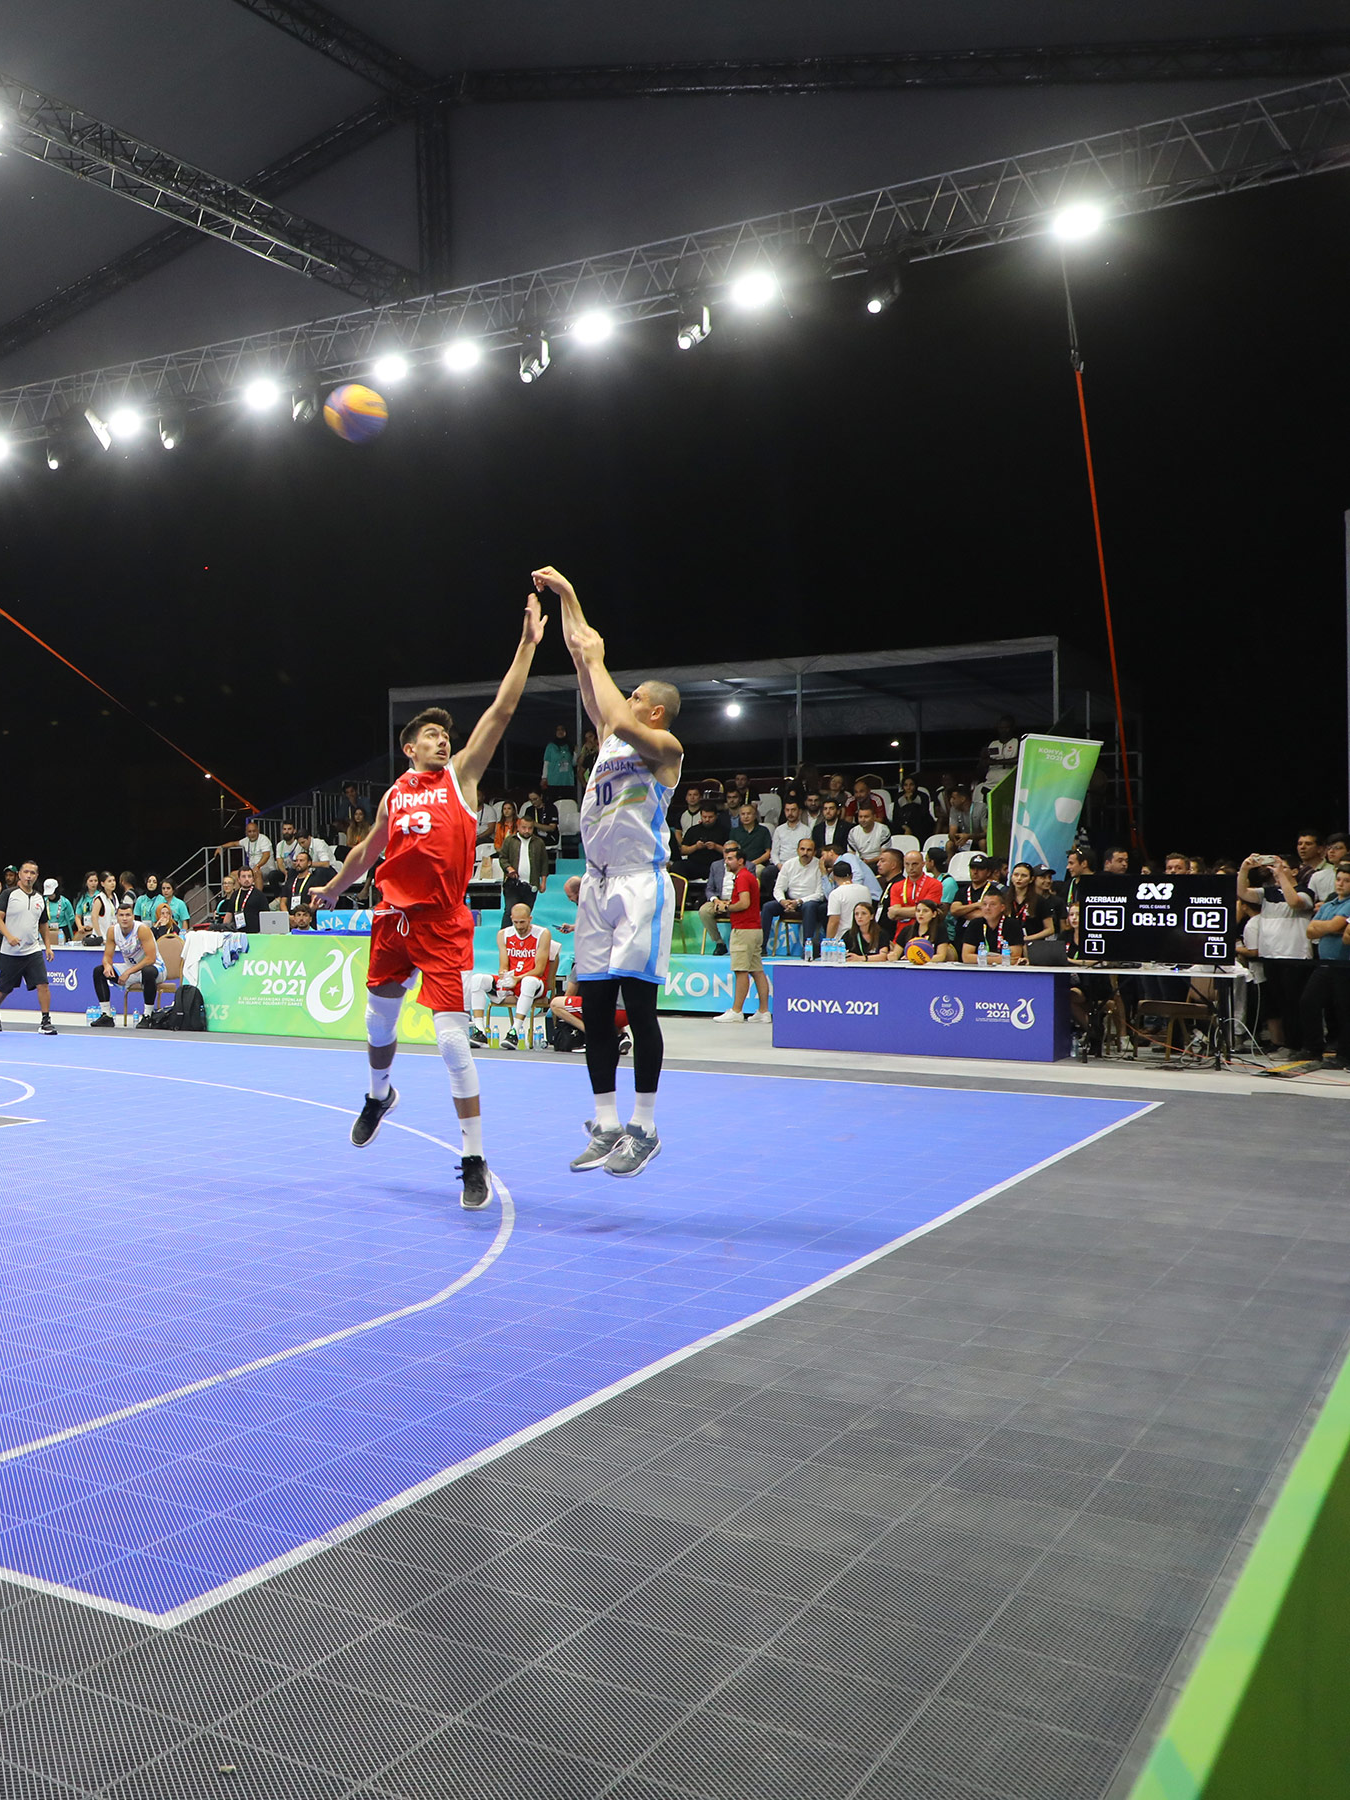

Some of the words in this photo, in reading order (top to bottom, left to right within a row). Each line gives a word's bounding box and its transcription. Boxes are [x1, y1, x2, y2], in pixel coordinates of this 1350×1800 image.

[1038, 747, 1063, 756] KONYA
[391, 788, 448, 814] TÜRKİYE
[595, 781, 613, 806] 10
[395, 811, 433, 835] 13
[1085, 896, 1128, 904] AZERBAIJAN
[1092, 909, 1118, 927] 05
[1132, 912, 1178, 927] 08:19
[1192, 911, 1221, 929] 02
[1091, 942, 1098, 951] 1
[1212, 945, 1219, 955] 1
[242, 960, 307, 977] KONYA
[515, 961, 525, 972] 5
[260, 979, 307, 995] 2021
[664, 972, 773, 999] KON
[787, 998, 843, 1014] KONYA
[845, 1001, 880, 1016] 2021
[975, 1001, 1010, 1010] KONYA
[986, 1010, 1010, 1018] 2021
